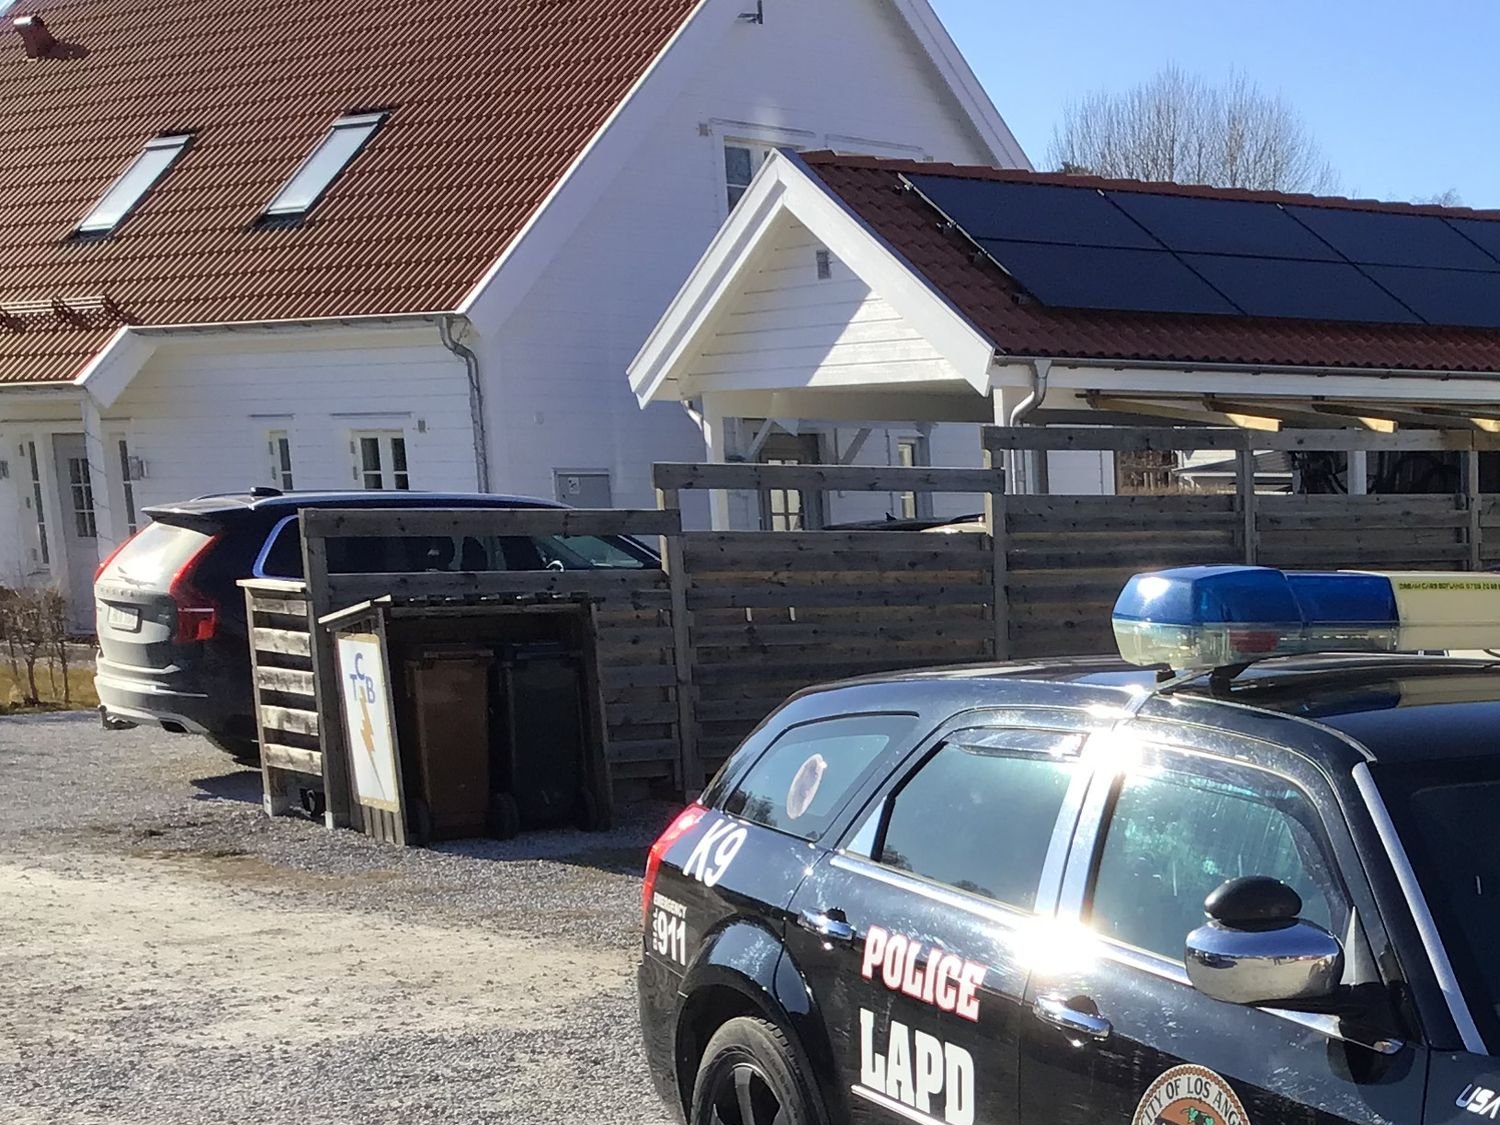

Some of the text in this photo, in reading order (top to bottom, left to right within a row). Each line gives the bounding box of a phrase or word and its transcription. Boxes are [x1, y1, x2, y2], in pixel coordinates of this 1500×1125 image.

[682, 819, 748, 887] K9
[657, 911, 686, 966] 911
[861, 924, 989, 1023] POLICE
[1165, 1078, 1182, 1099] OF
[1187, 1077, 1212, 1098] LOS
